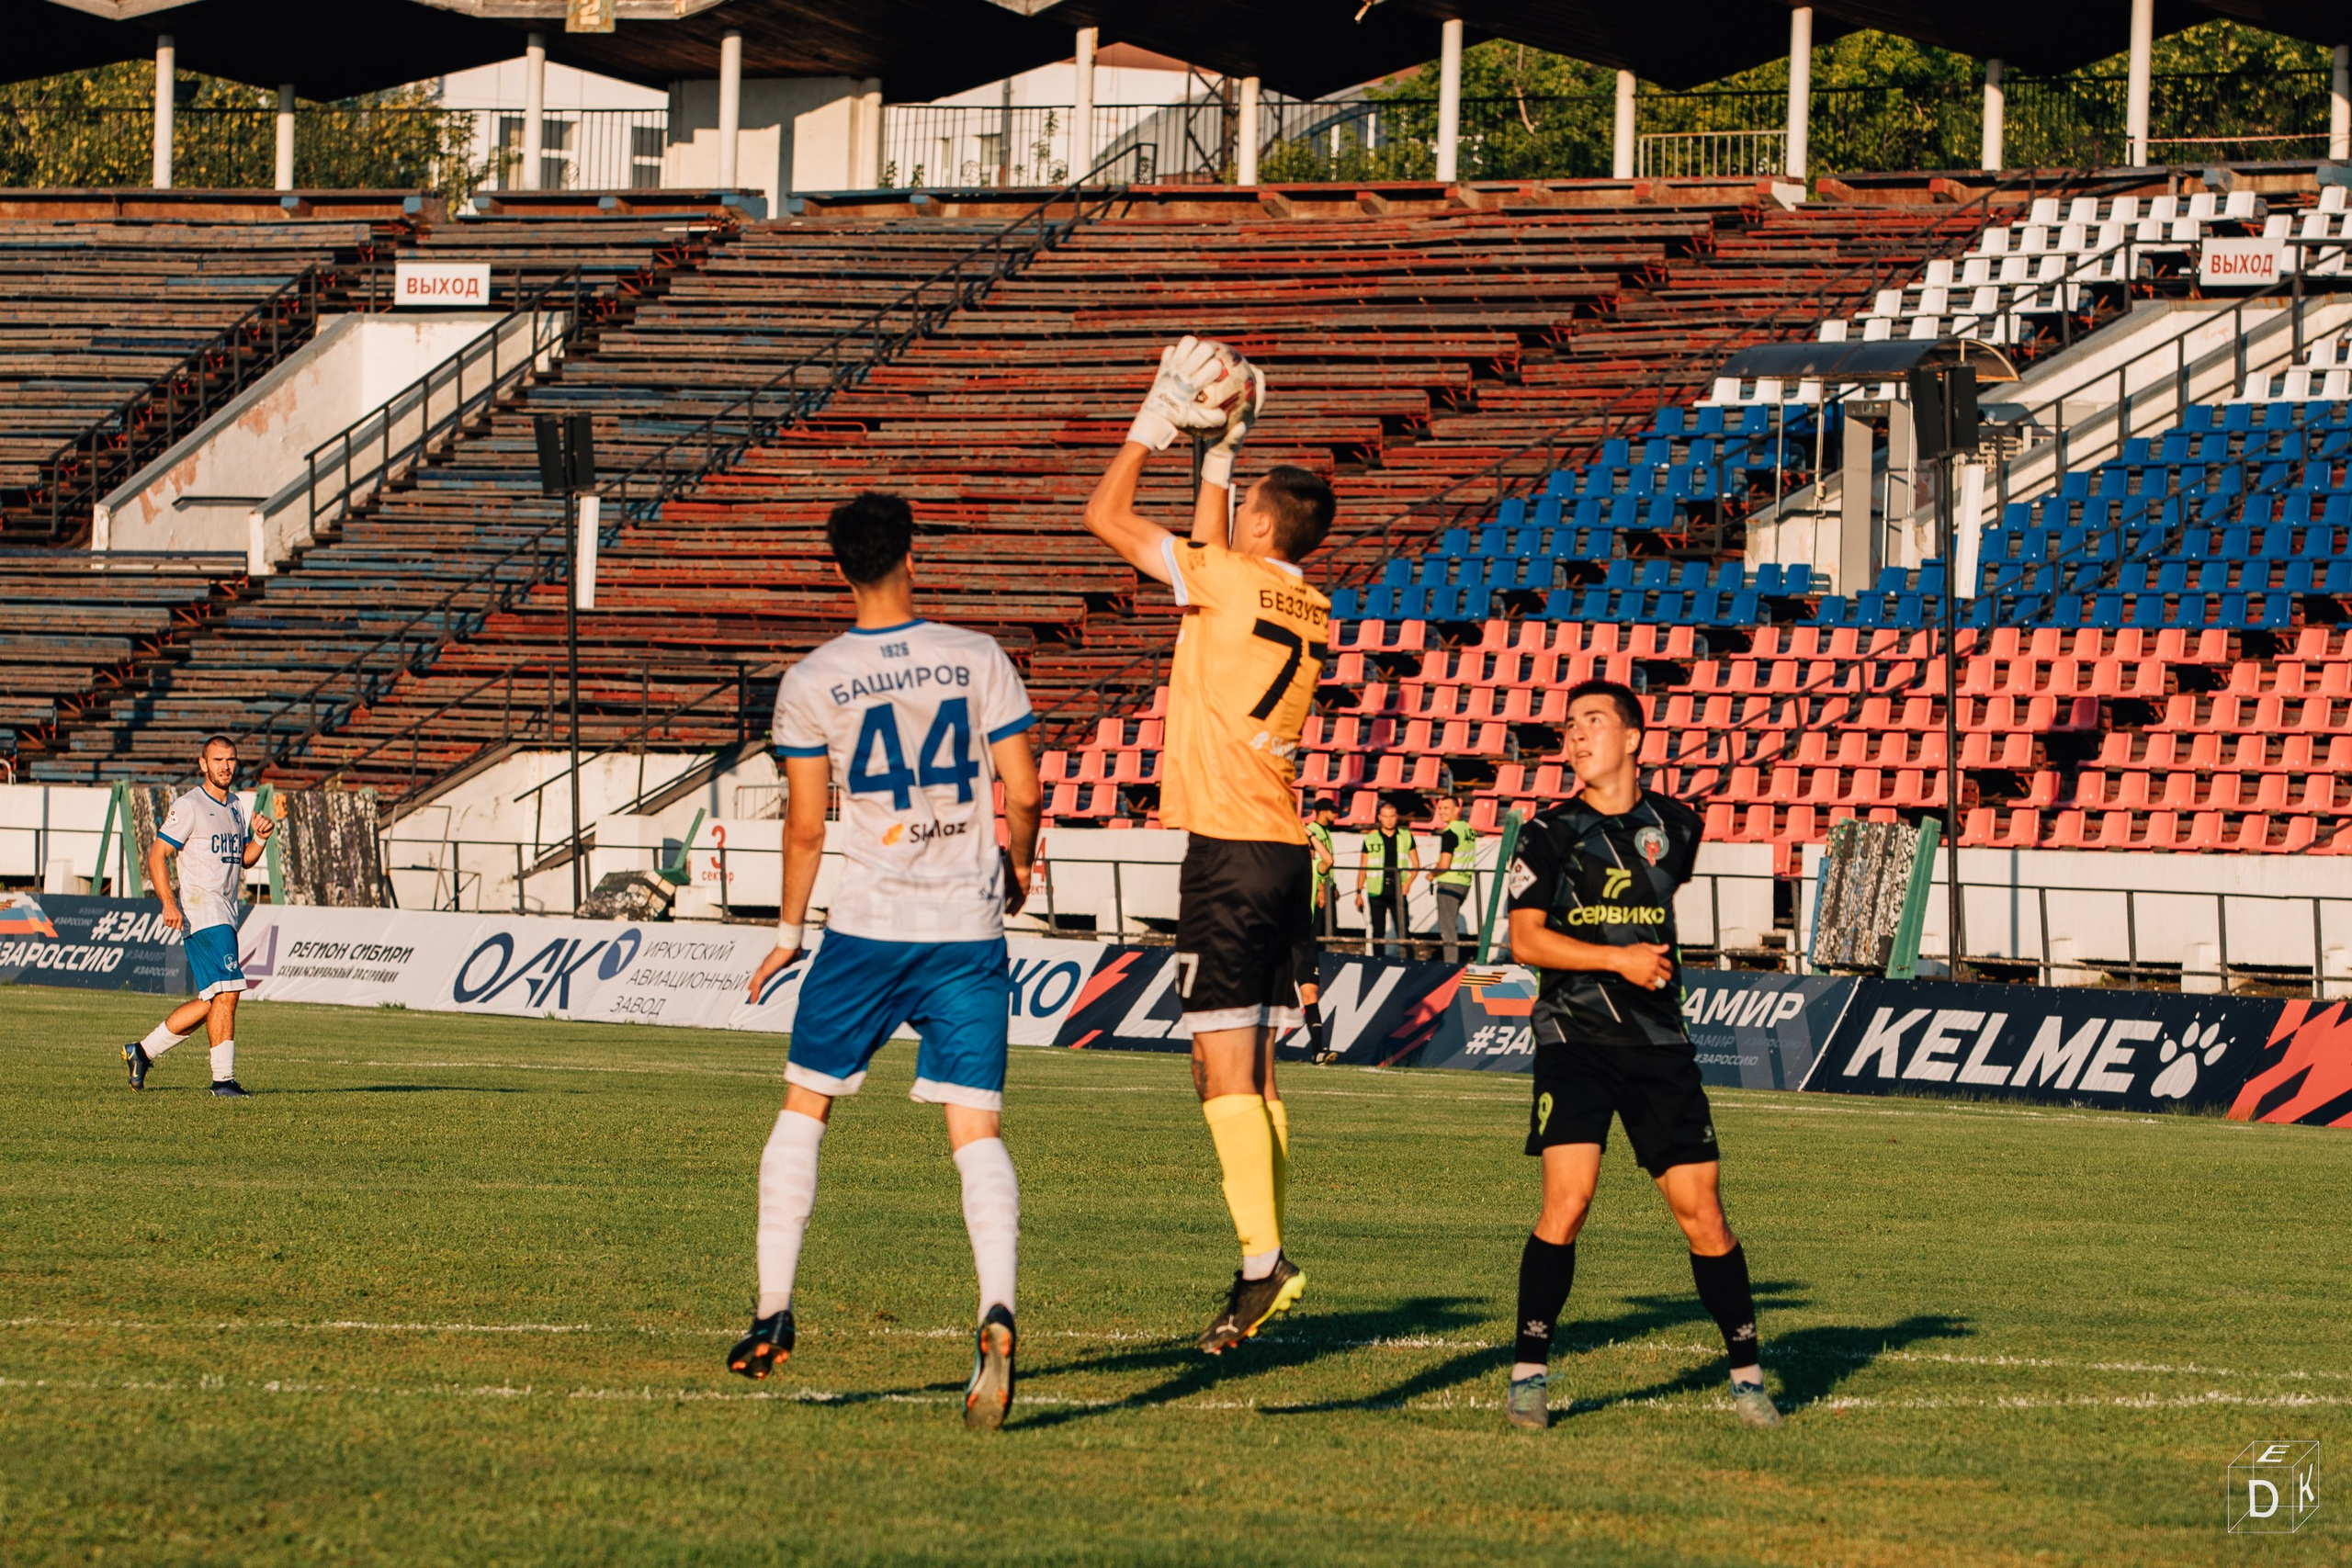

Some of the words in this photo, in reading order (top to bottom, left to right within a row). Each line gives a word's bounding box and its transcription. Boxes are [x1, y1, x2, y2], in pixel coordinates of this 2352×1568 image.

[2211, 254, 2273, 277] ВЫХОД
[407, 277, 480, 298] ВЫХОД
[831, 665, 970, 705] БАШИРОВ
[847, 696, 979, 811] 44
[710, 825, 726, 869] 3
[1033, 837, 1047, 883] 4
[0, 942, 124, 973] ЗАРОССИЮ
[288, 941, 350, 960] РЕГИОН
[349, 943, 414, 964] СИБИРИ
[453, 932, 609, 1010] ОАК
[643, 940, 736, 962] ИРКУТСКИЙ
[627, 969, 752, 992] АВИАЦИОННЫЙ
[1008, 957, 1081, 1019] КО
[609, 996, 667, 1017] ЗАВОД
[1113, 952, 1407, 1054] LN
[1680, 987, 1805, 1028] АМИР
[1693, 1053, 1758, 1066] #ЗАРОССИЮ
[1842, 1006, 2164, 1094] KELME
[1538, 1091, 1554, 1136] 9
